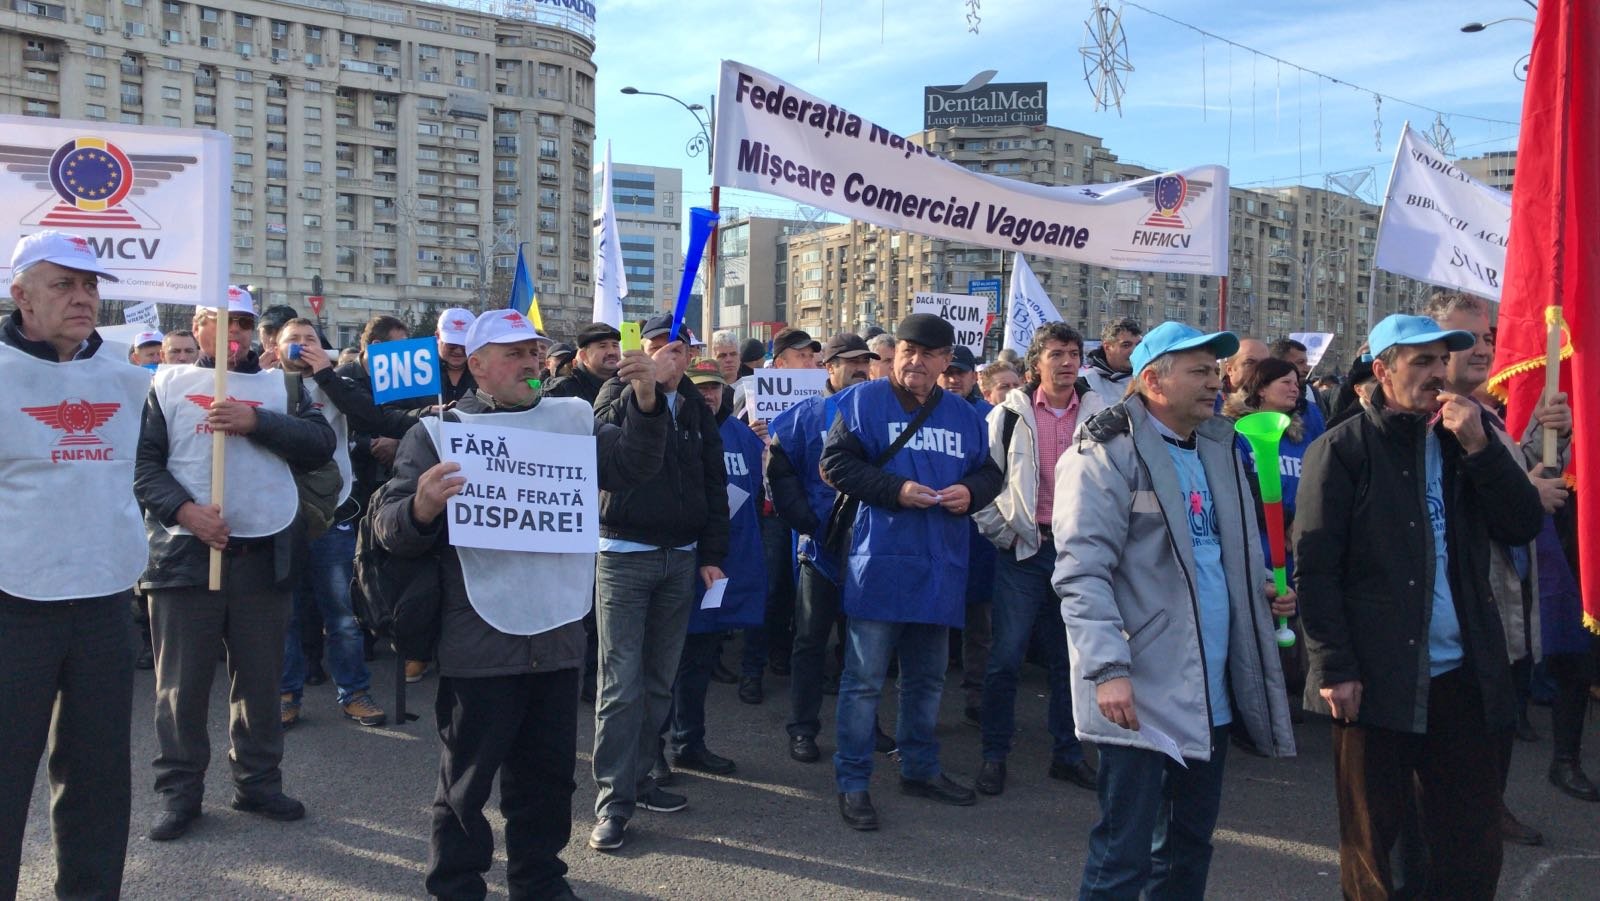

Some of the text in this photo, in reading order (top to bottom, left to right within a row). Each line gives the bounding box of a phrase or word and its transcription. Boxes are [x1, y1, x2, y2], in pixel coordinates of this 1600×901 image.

[927, 89, 1044, 113] DentalMed
[928, 111, 1044, 126] Luxury Dental Clinic
[1411, 148, 1471, 184] SINDICA
[737, 138, 1089, 249] Mișcare Comercial Vagoane
[87, 236, 160, 260] MCV
[1132, 230, 1191, 249] FNFMCV
[940, 305, 984, 325] ACUM,
[373, 349, 433, 392] BNS
[757, 377, 792, 396] NU
[757, 401, 796, 412] CALE
[450, 433, 510, 458] FĂRĂ
[486, 456, 588, 483] INVESTIȚII,
[517, 488, 584, 507] FERATĂ
[455, 502, 583, 533] DISPARE!
